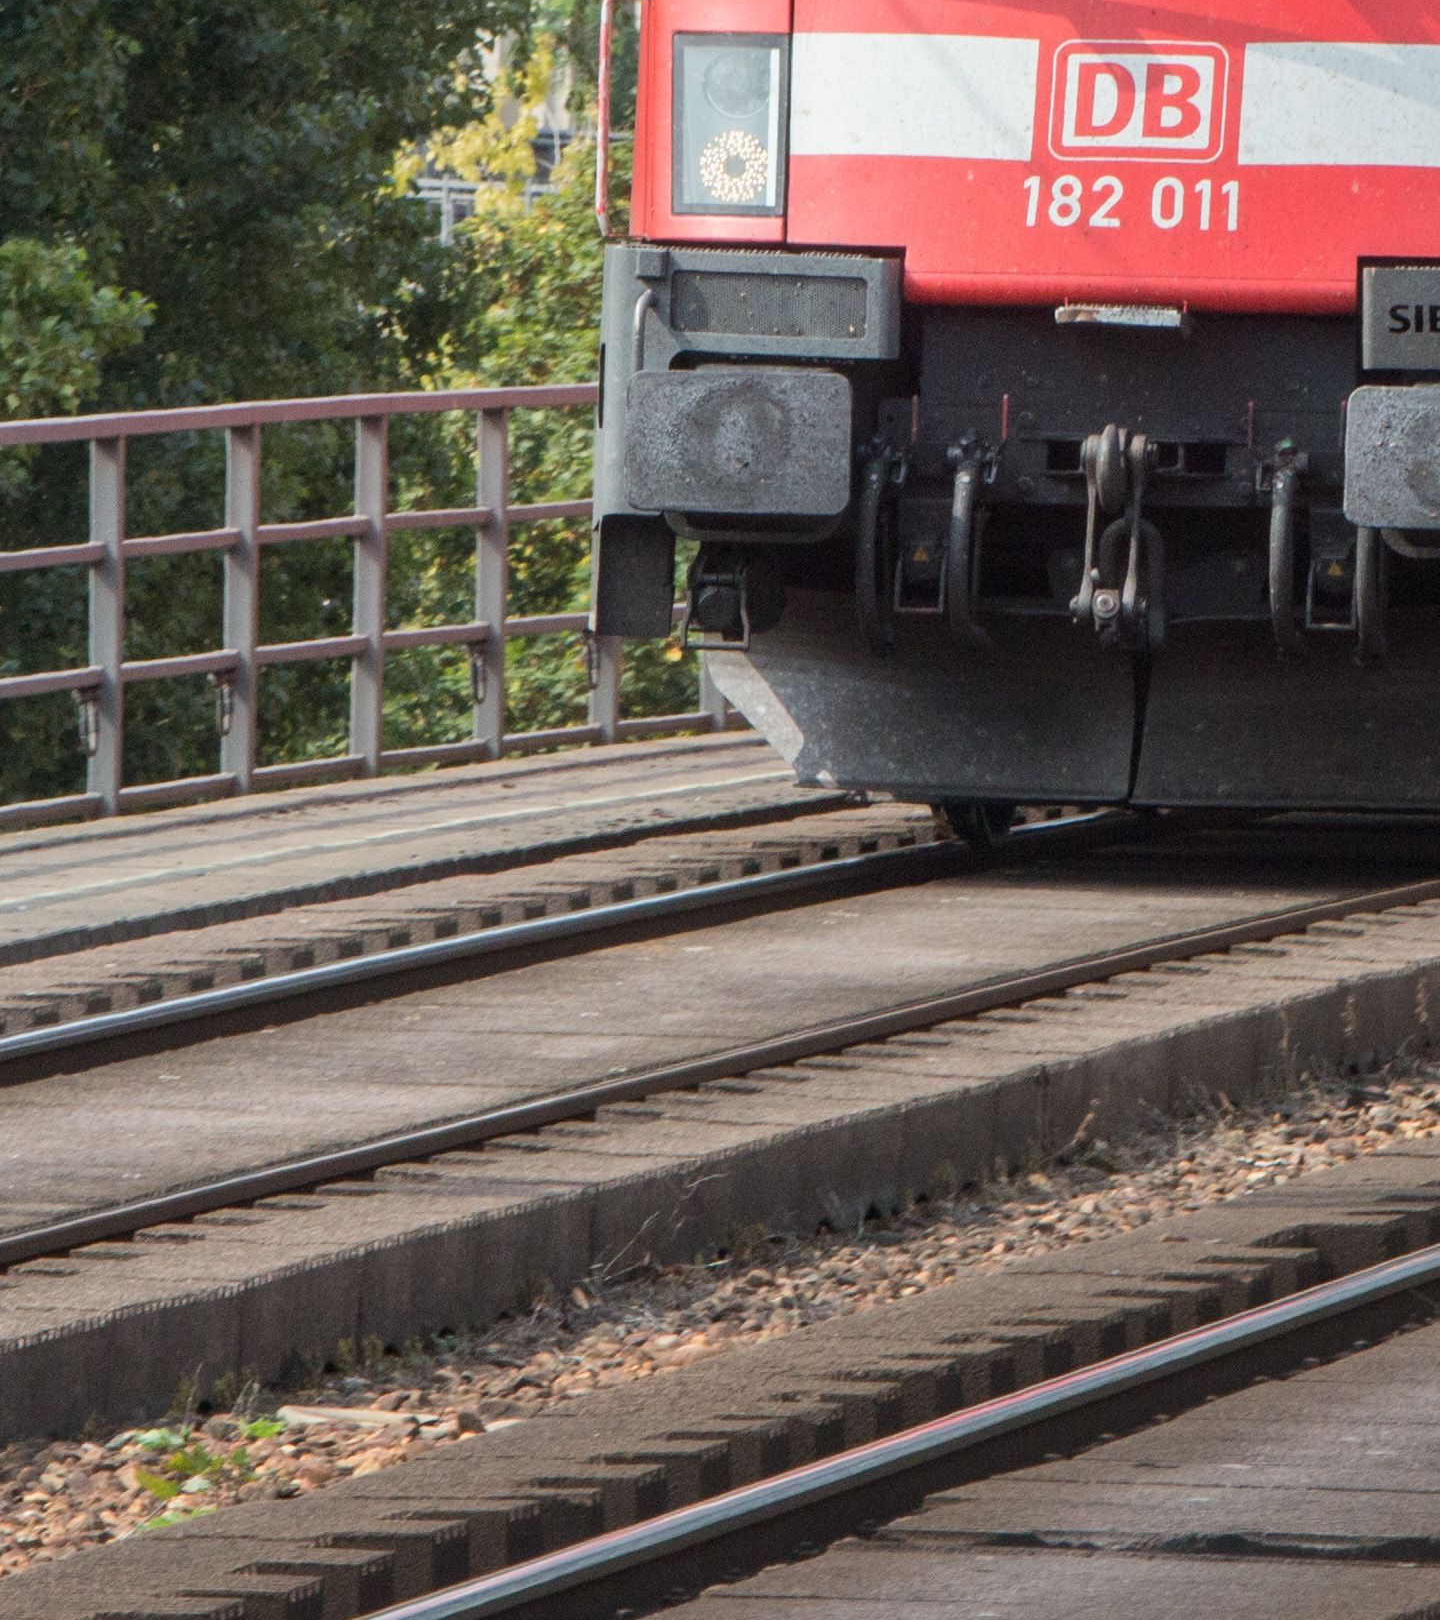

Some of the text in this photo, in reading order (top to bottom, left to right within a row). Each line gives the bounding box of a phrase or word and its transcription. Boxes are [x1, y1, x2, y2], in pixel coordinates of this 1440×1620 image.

[1073, 61, 1203, 140] DB
[1023, 174, 1240, 231] 182 011
